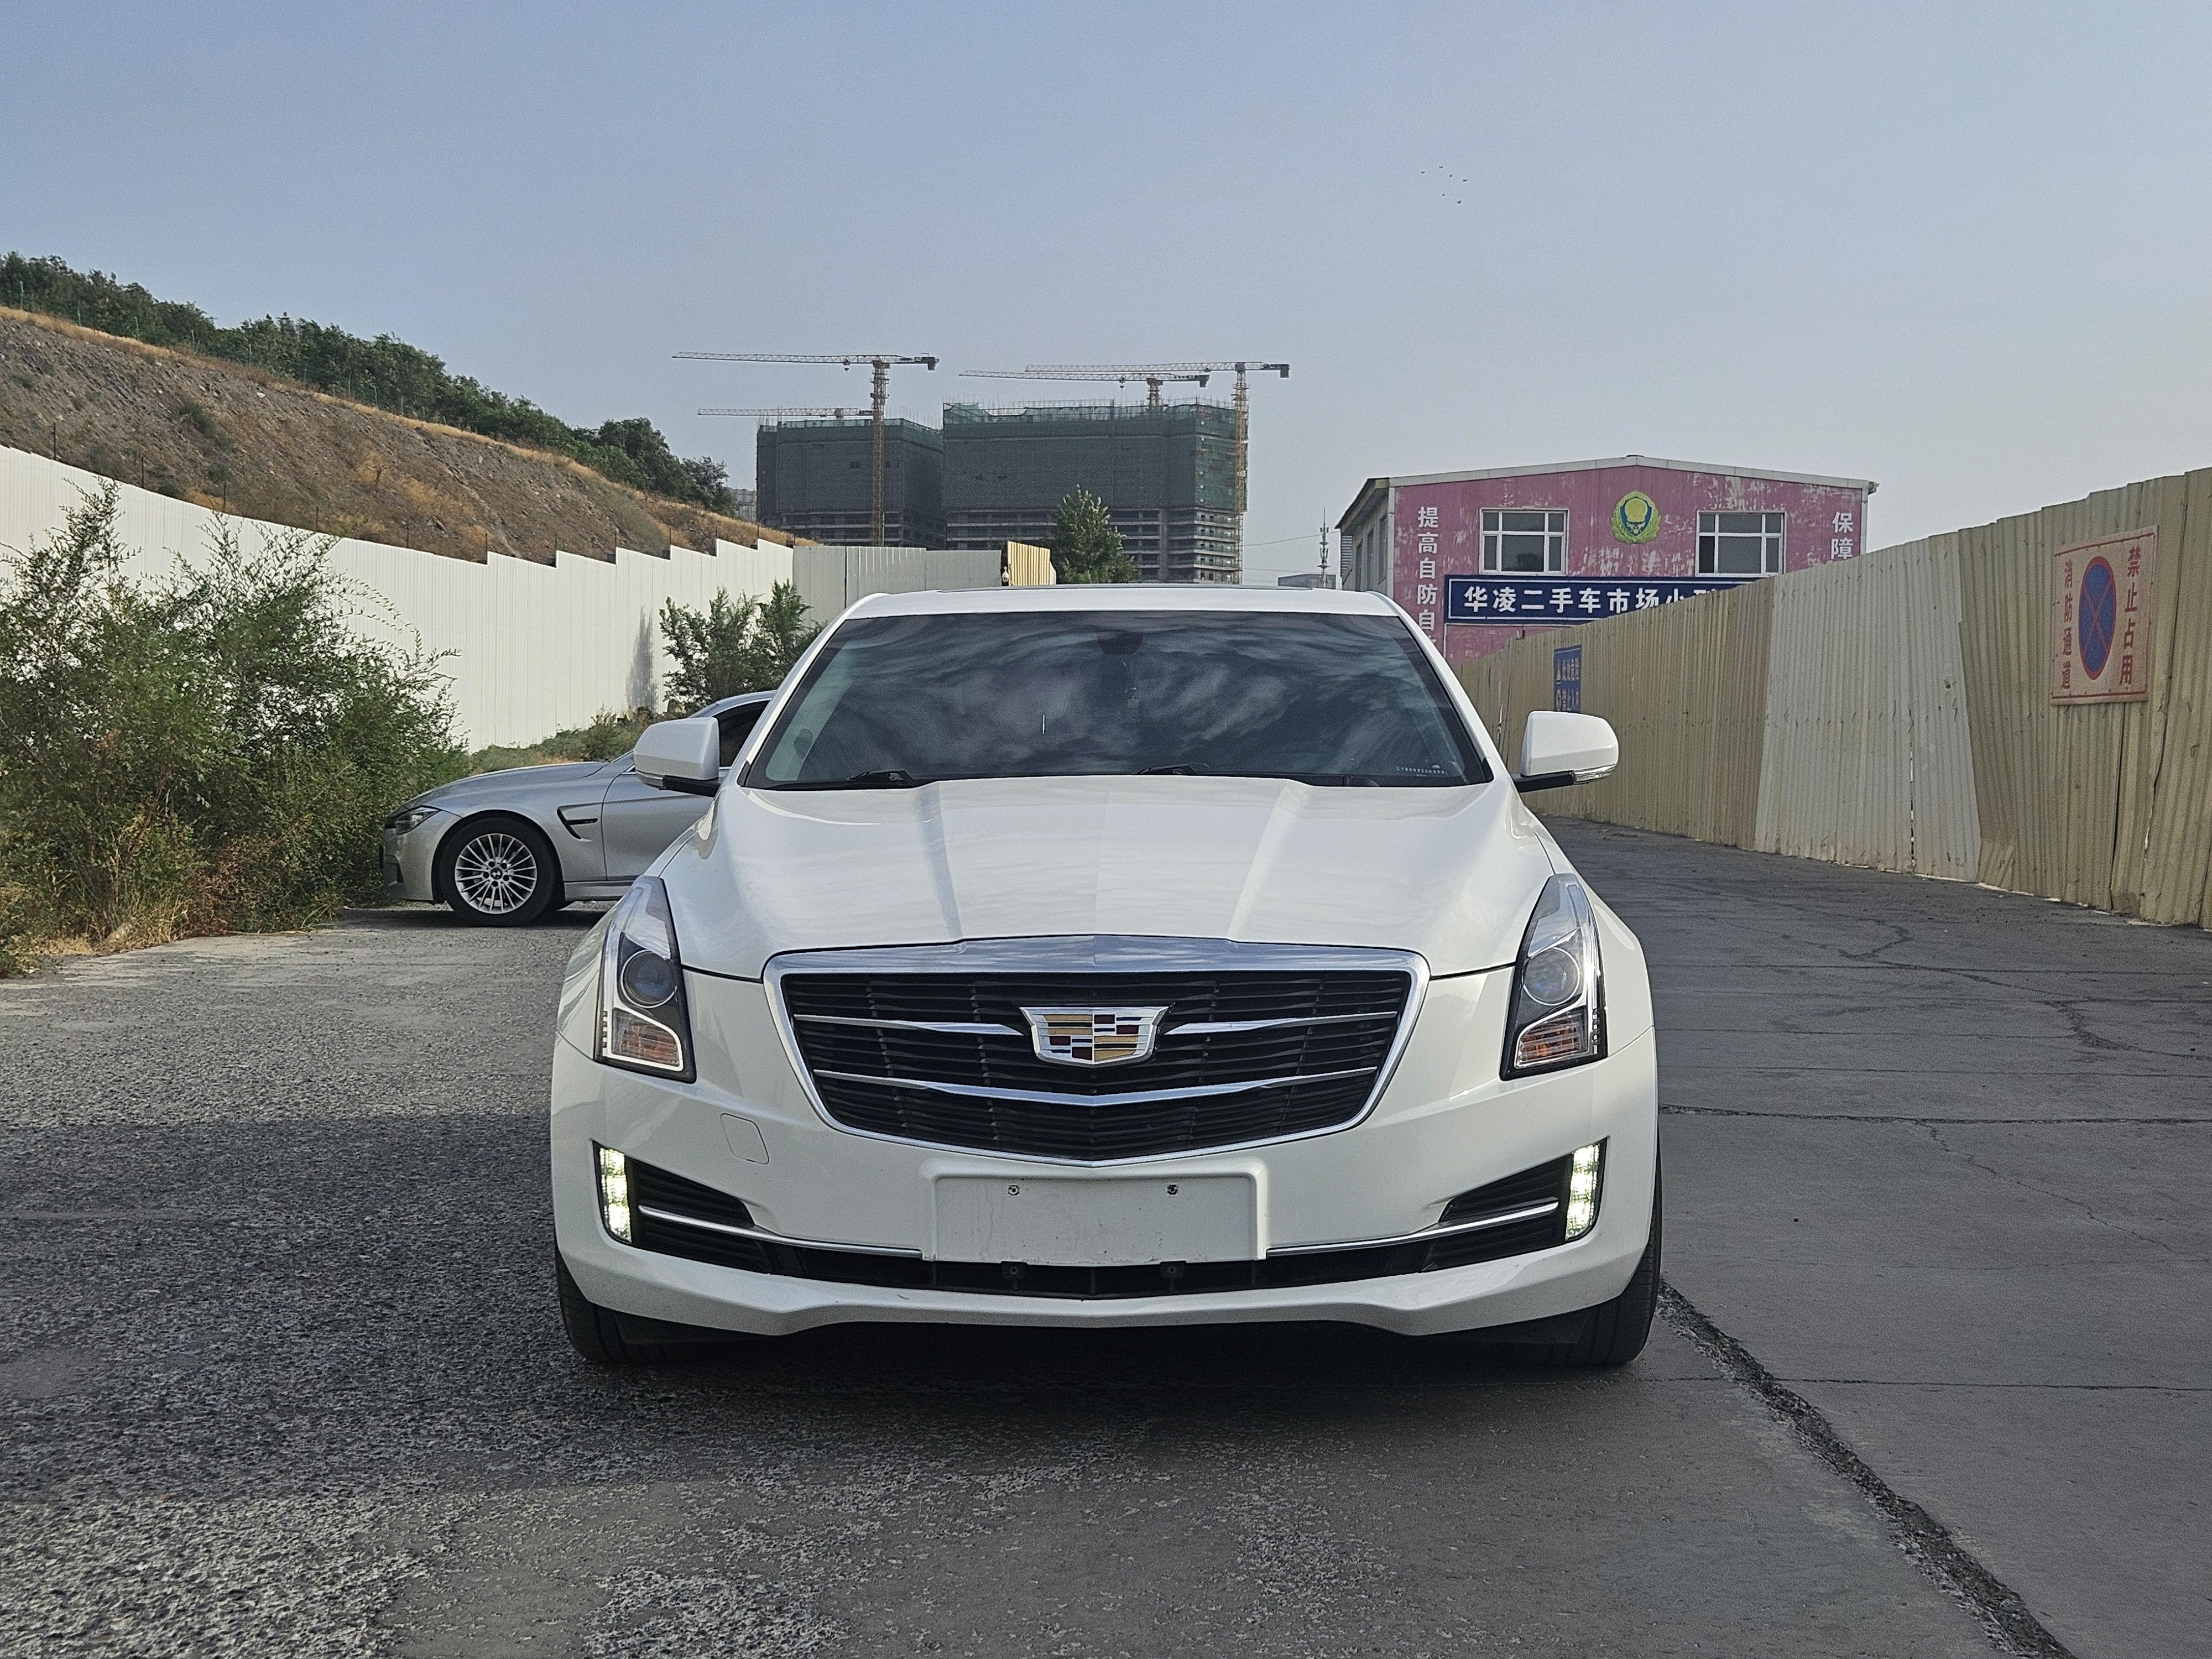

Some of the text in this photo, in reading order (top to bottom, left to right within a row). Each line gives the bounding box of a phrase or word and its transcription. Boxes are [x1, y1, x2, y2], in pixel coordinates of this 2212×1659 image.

[1417, 507, 1438, 644] 提高自防自
[1830, 512, 1854, 560] 保障
[2061, 560, 2074, 690] 消防通道
[2119, 545, 2141, 685] 禁止占用
